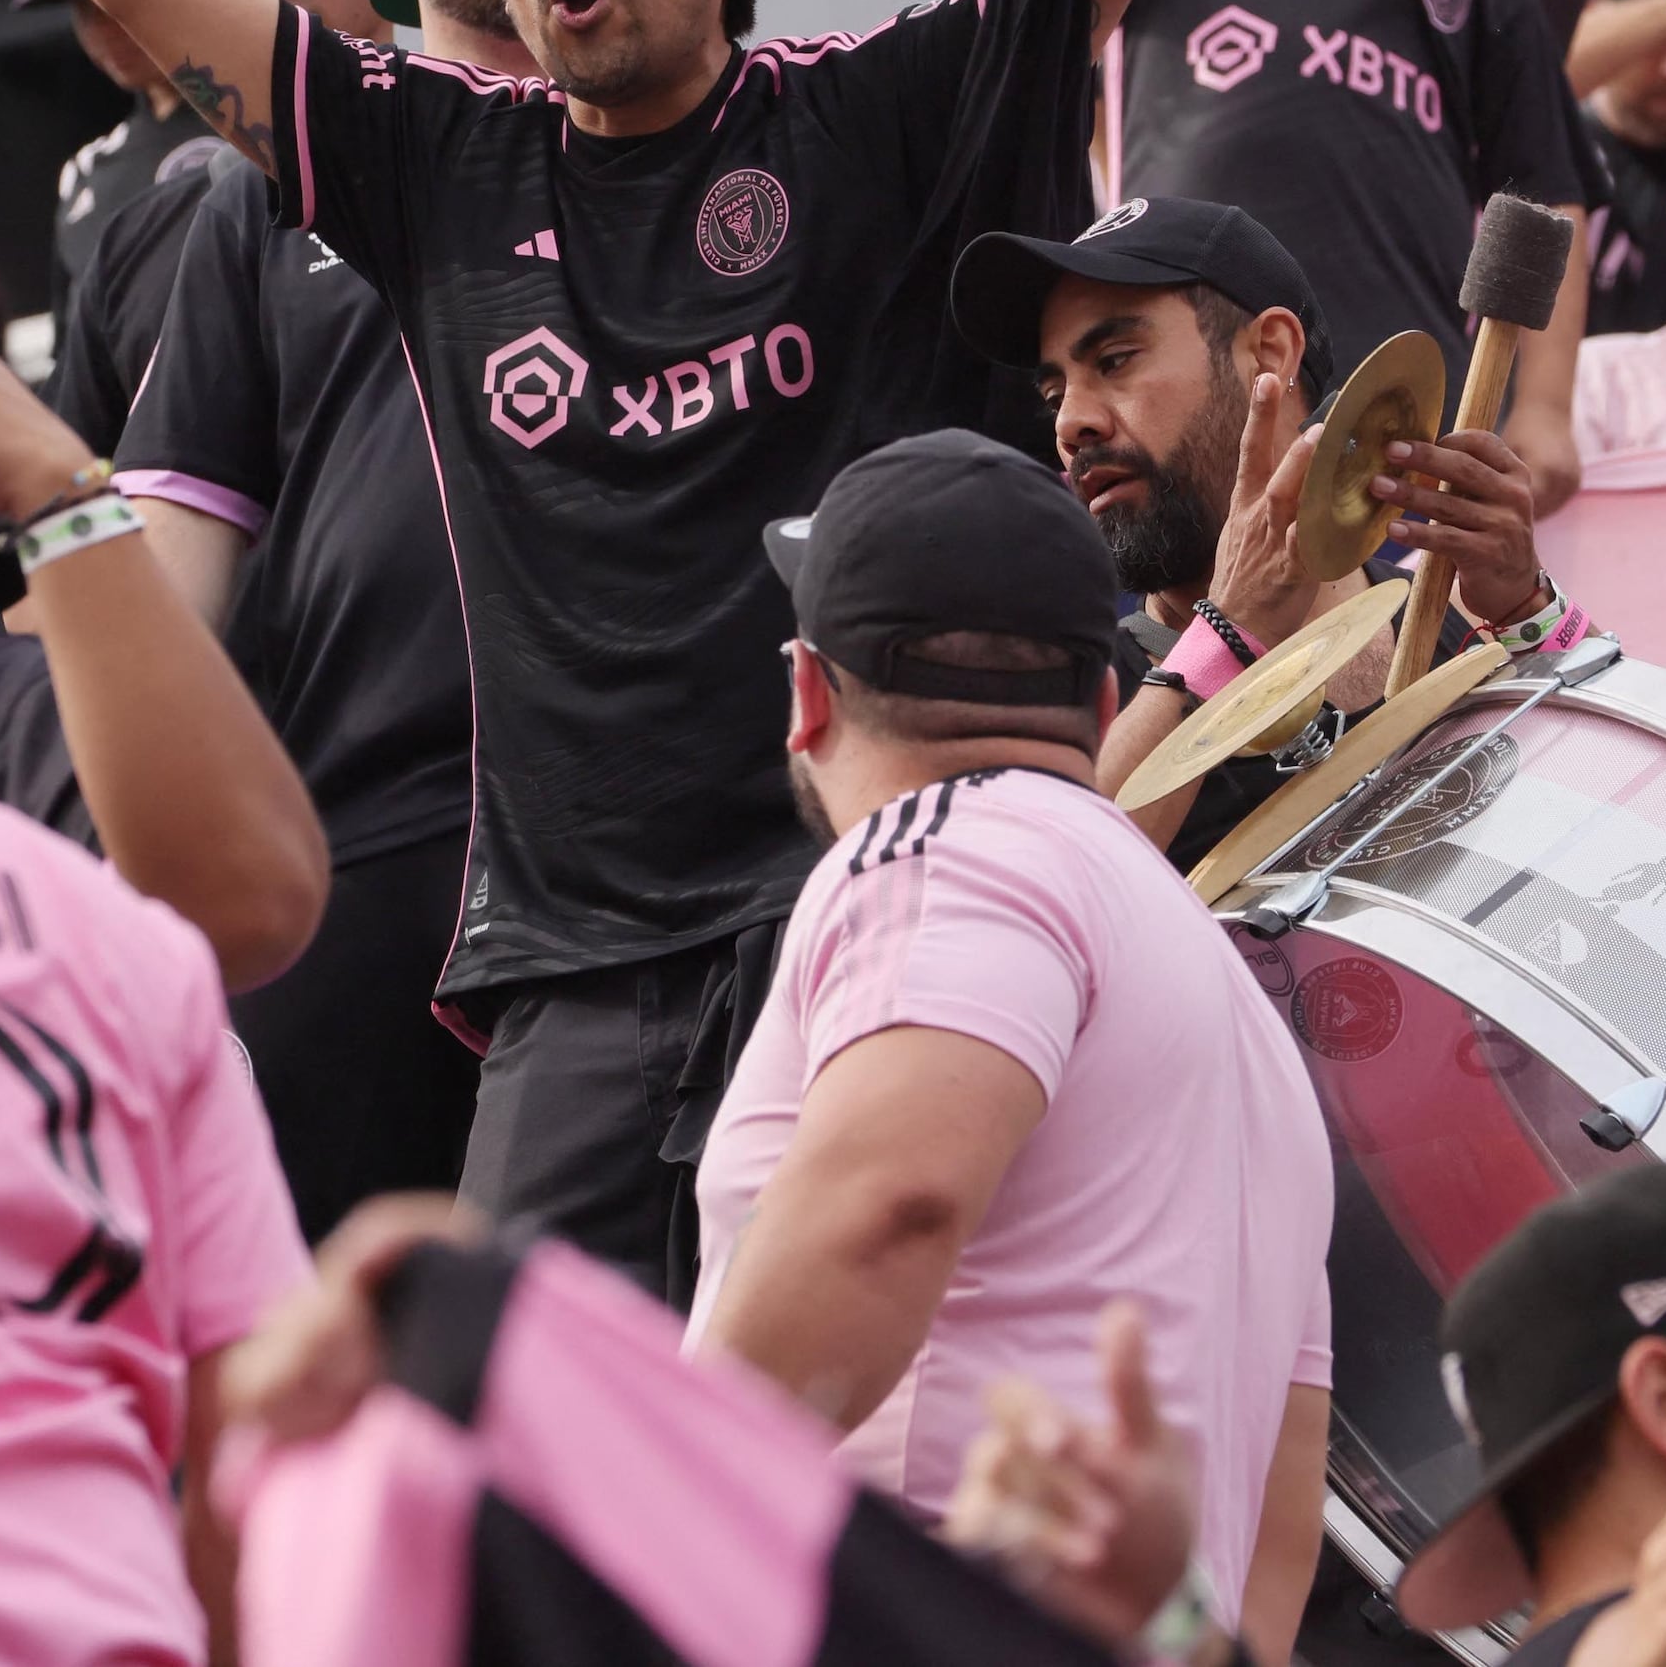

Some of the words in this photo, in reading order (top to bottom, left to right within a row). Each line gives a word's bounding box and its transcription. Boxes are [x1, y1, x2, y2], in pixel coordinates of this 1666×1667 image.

[1300, 25, 1442, 132] XBTO
[718, 192, 753, 218] MIAMI
[759, 179, 773, 191] DE
[700, 175, 757, 240] INTERNACIONAL
[702, 242, 721, 266] CLUB
[609, 323, 814, 438] XBTO
[1556, 605, 1584, 649] MEMBER
